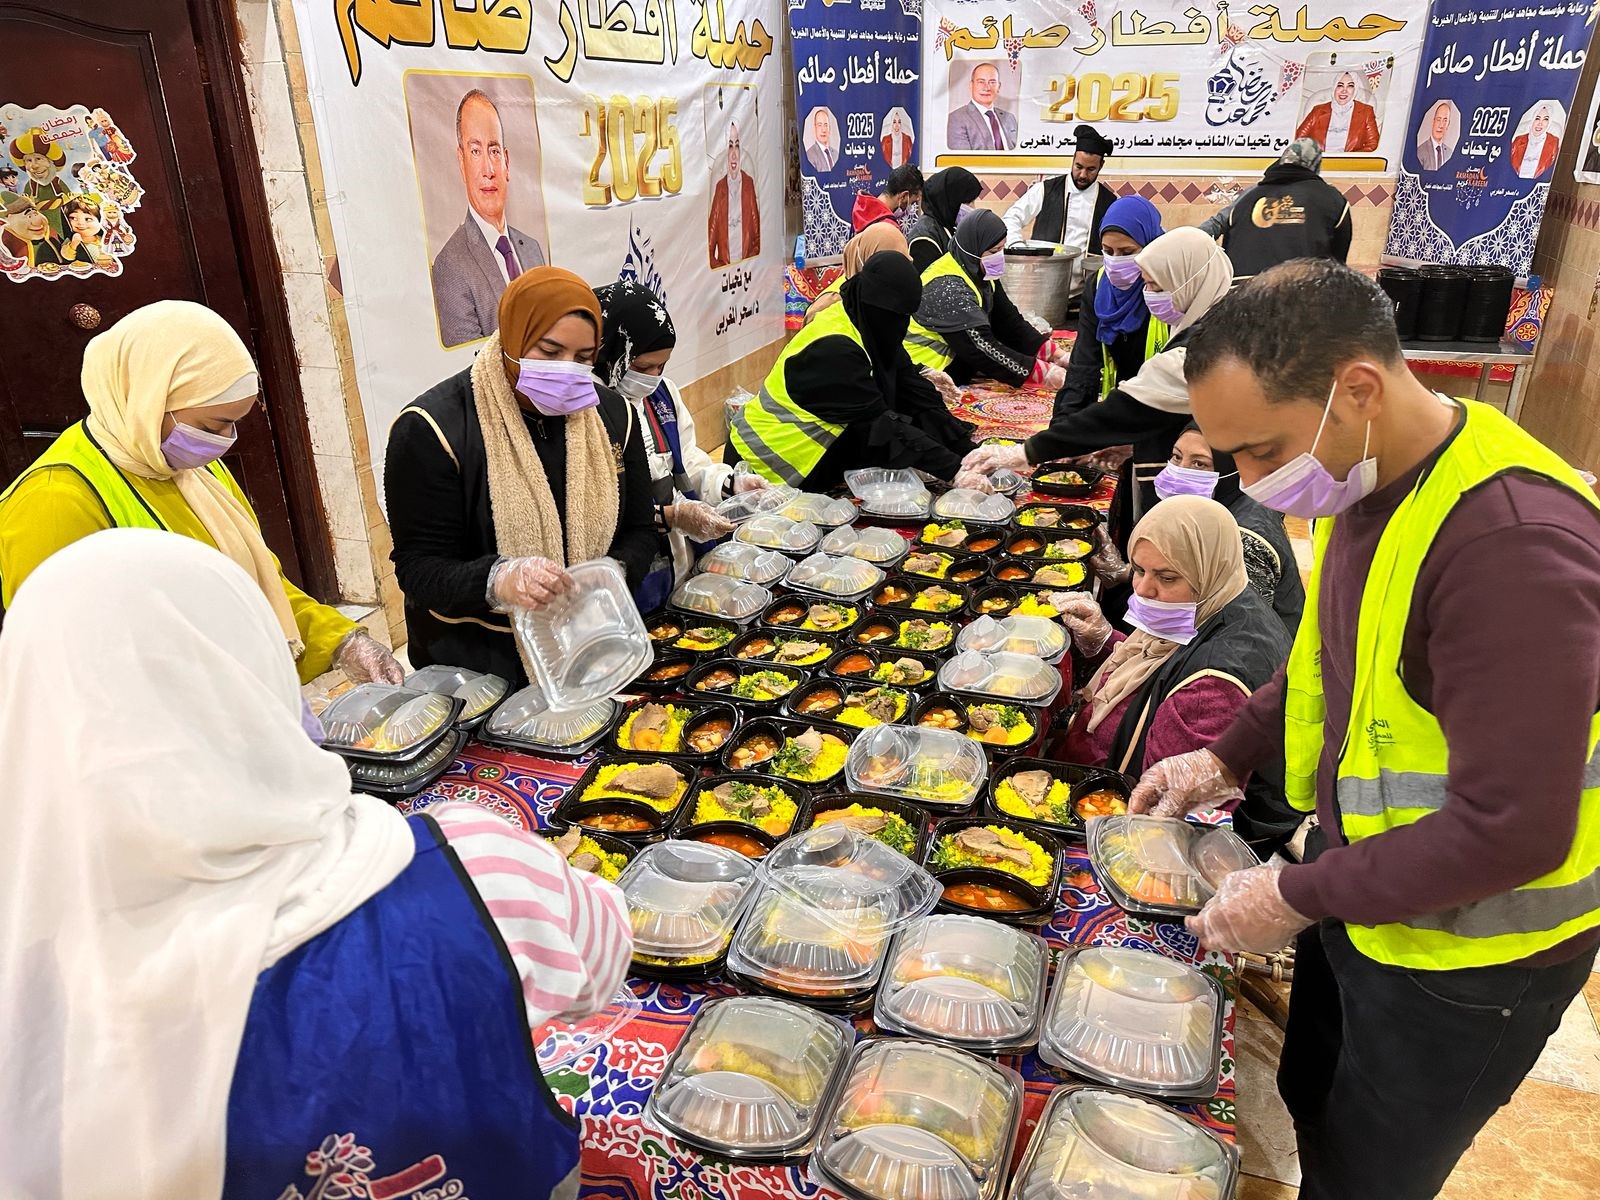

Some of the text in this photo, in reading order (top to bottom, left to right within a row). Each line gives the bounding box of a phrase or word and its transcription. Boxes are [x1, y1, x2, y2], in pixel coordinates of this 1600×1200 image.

[906, 32, 919, 42] تحت
[944, 0, 1408, 61] حملة أفطار صائم
[1426, 29, 1588, 88] حملة أفطار صائم
[797, 50, 919, 97] حملة أفطار صائم
[1040, 72, 1181, 122] 2025
[41, 115, 78, 132] رمضان
[847, 112, 875, 139] 2025
[1469, 106, 1511, 137] 2025
[40, 127, 84, 144] يجمعنا
[1126, 135, 1154, 151] نصار
[1157, 136, 1193, 151] مجاهد
[1274, 138, 1289, 151] مع
[579, 94, 684, 205] 2025
[844, 142, 876, 160] مع تحيات
[1461, 141, 1502, 163] مع تحيات
[721, 267, 752, 295] مع تحيات
